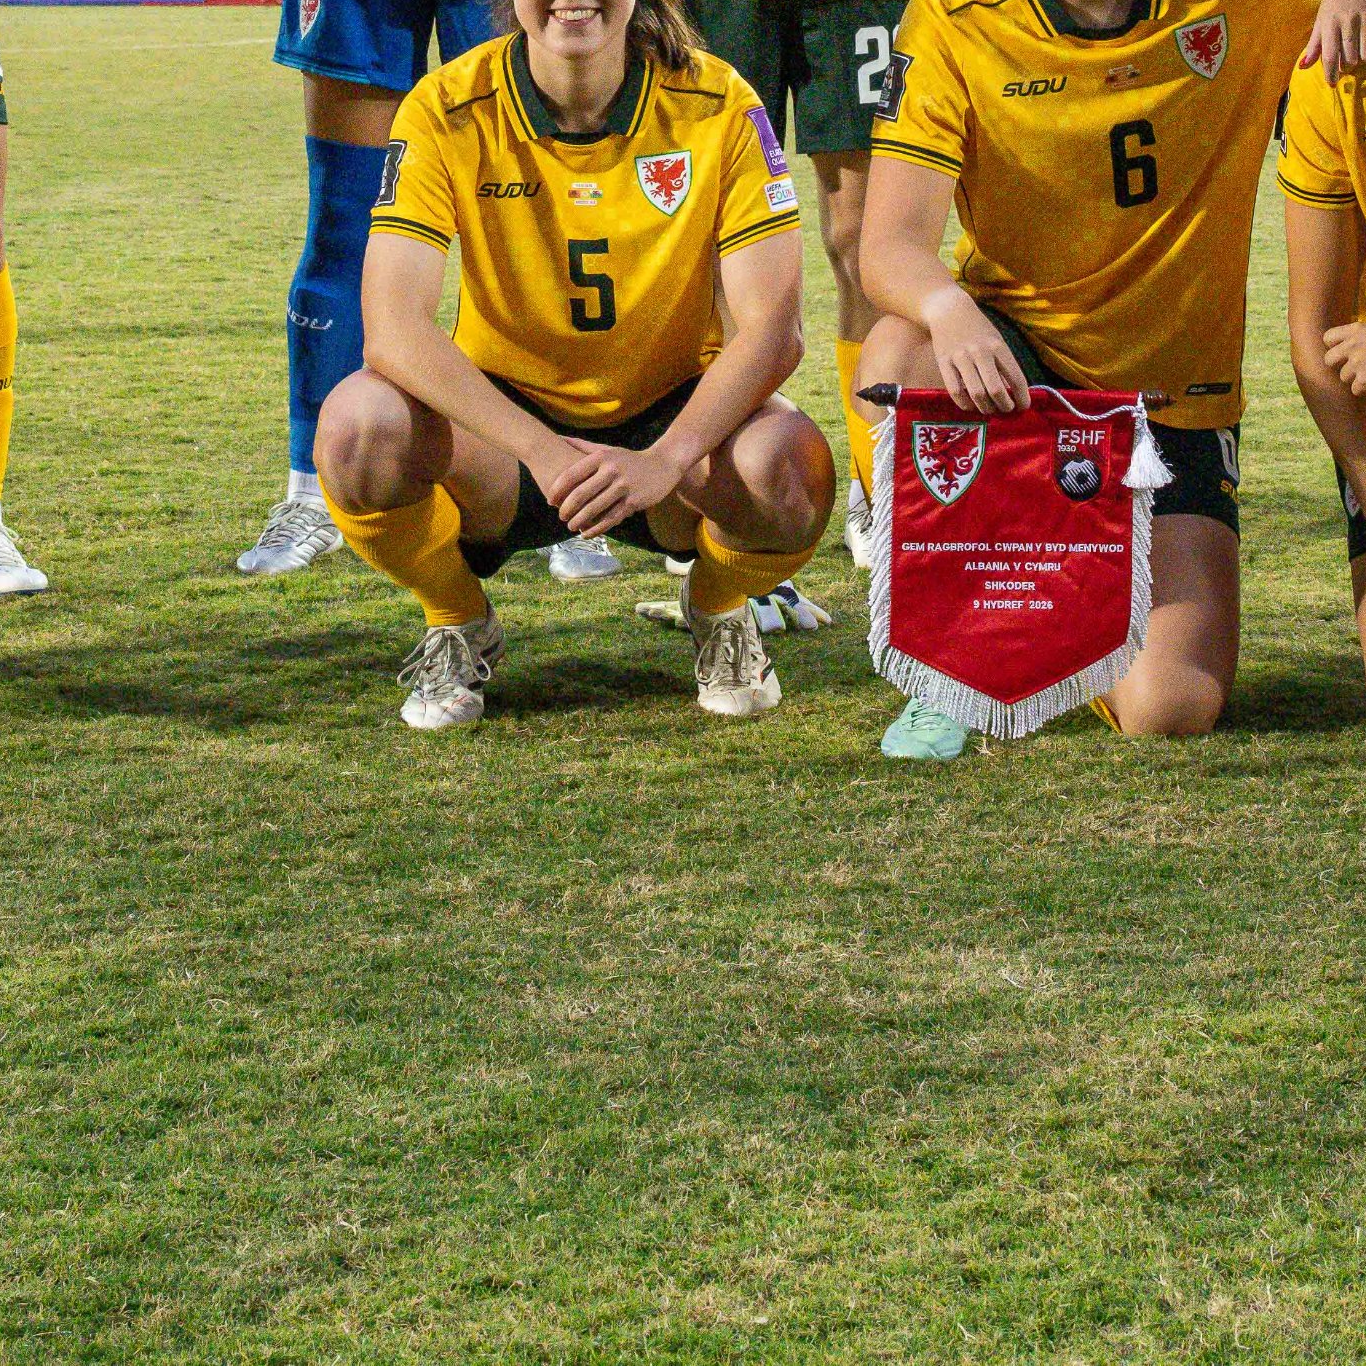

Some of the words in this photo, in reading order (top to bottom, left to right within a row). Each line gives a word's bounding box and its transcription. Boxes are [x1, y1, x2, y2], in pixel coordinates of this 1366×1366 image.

[1002, 75, 1068, 98] SUDU
[1108, 118, 1159, 209] 6
[476, 181, 541, 199] SUDU
[567, 238, 617, 332] 5
[1058, 429, 1106, 445] FSHF
[1058, 445, 1077, 453] 1930
[901, 542, 925, 552] GEM
[927, 542, 992, 552] RAGBROFOL
[994, 542, 1033, 553] CWPAN
[1035, 542, 1043, 553] Y
[1045, 543, 1067, 553] BYD
[1068, 543, 1125, 553] MENYWOD
[964, 561, 1011, 572] ALBANIA
[1013, 561, 1022, 571] V
[1024, 562, 1061, 572] CYMRU
[984, 580, 1036, 591] SHKODER
[973, 599, 980, 610] 9
[983, 600, 1025, 610] HYDREF
[1028, 600, 1054, 610] 2026
